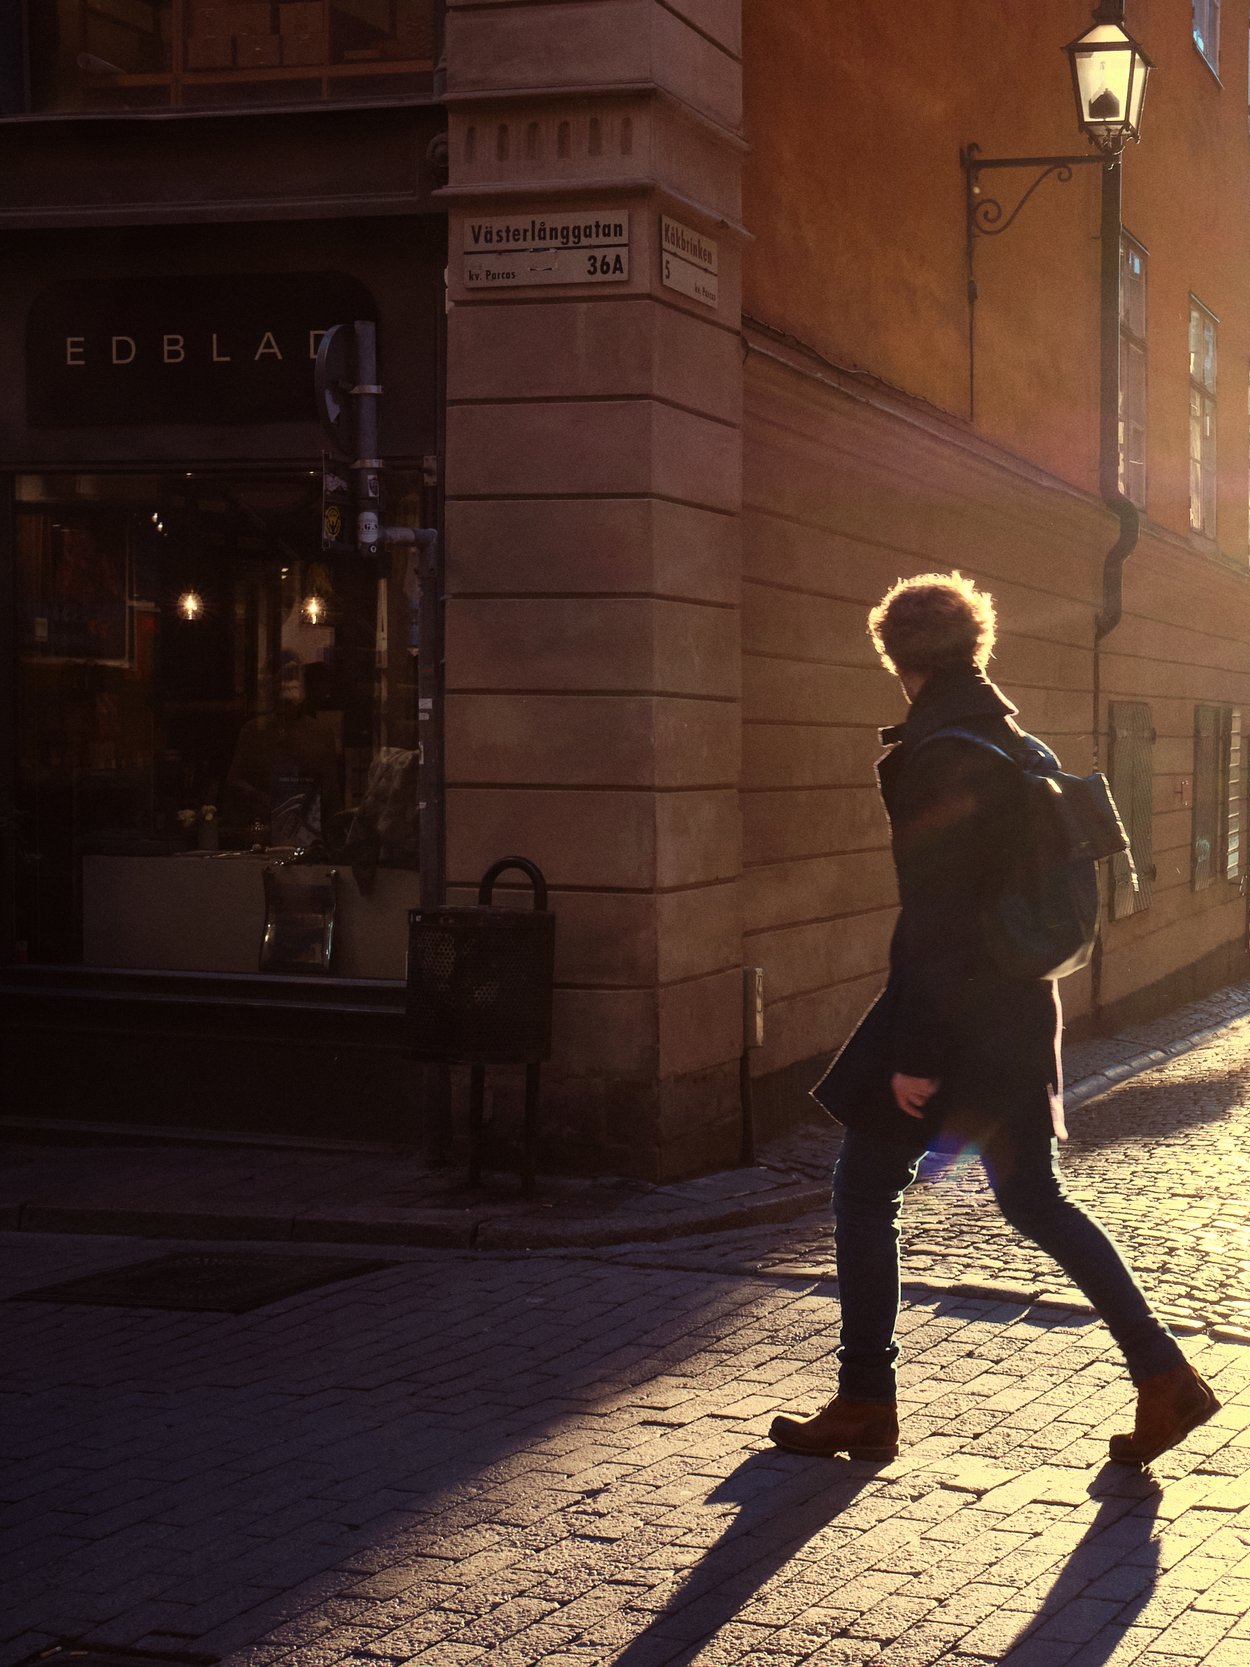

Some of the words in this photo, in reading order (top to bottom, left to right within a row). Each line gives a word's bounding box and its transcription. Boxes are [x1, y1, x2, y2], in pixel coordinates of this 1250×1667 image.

[470, 220, 624, 245] Västerlånggatan
[663, 222, 713, 264] Kåkbrinken
[468, 271, 482, 281] kv.
[485, 269, 516, 281] Parcas
[587, 254, 624, 276] 36A
[664, 260, 671, 280] 5
